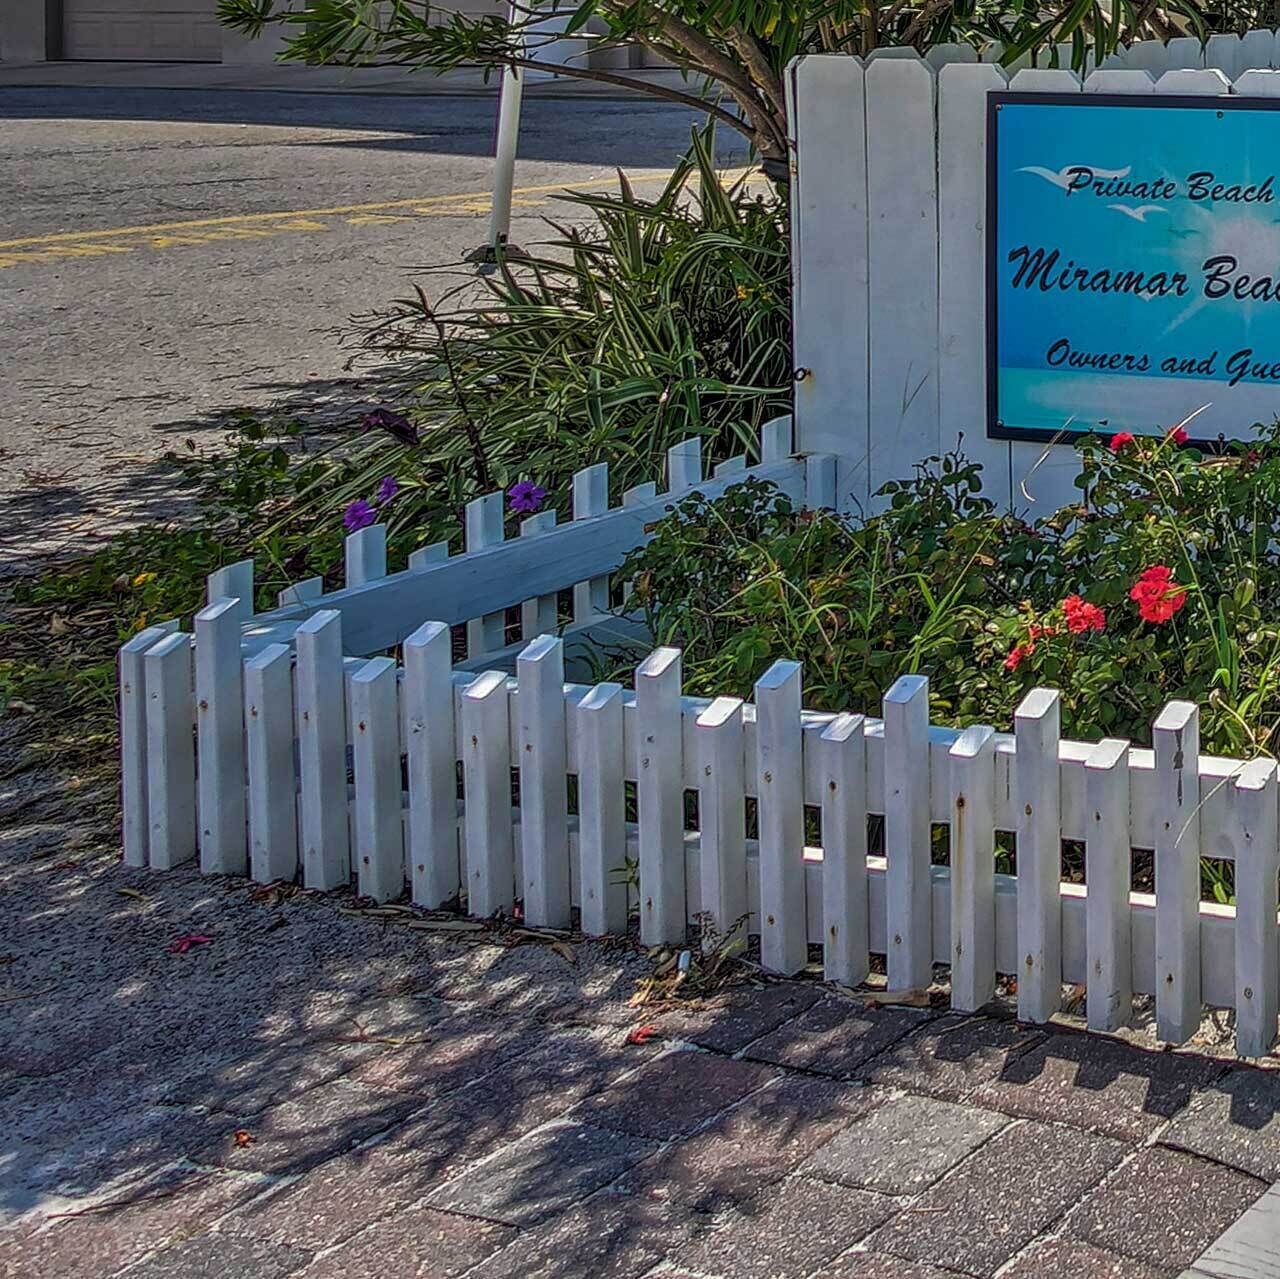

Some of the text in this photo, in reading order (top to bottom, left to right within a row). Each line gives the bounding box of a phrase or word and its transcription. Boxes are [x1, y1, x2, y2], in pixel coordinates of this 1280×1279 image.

[1066, 166, 1176, 201] Private
[1186, 172, 1275, 205] Beach
[1007, 245, 1190, 297] Miramar
[1046, 338, 1151, 373] Owners
[1160, 351, 1217, 376] and
